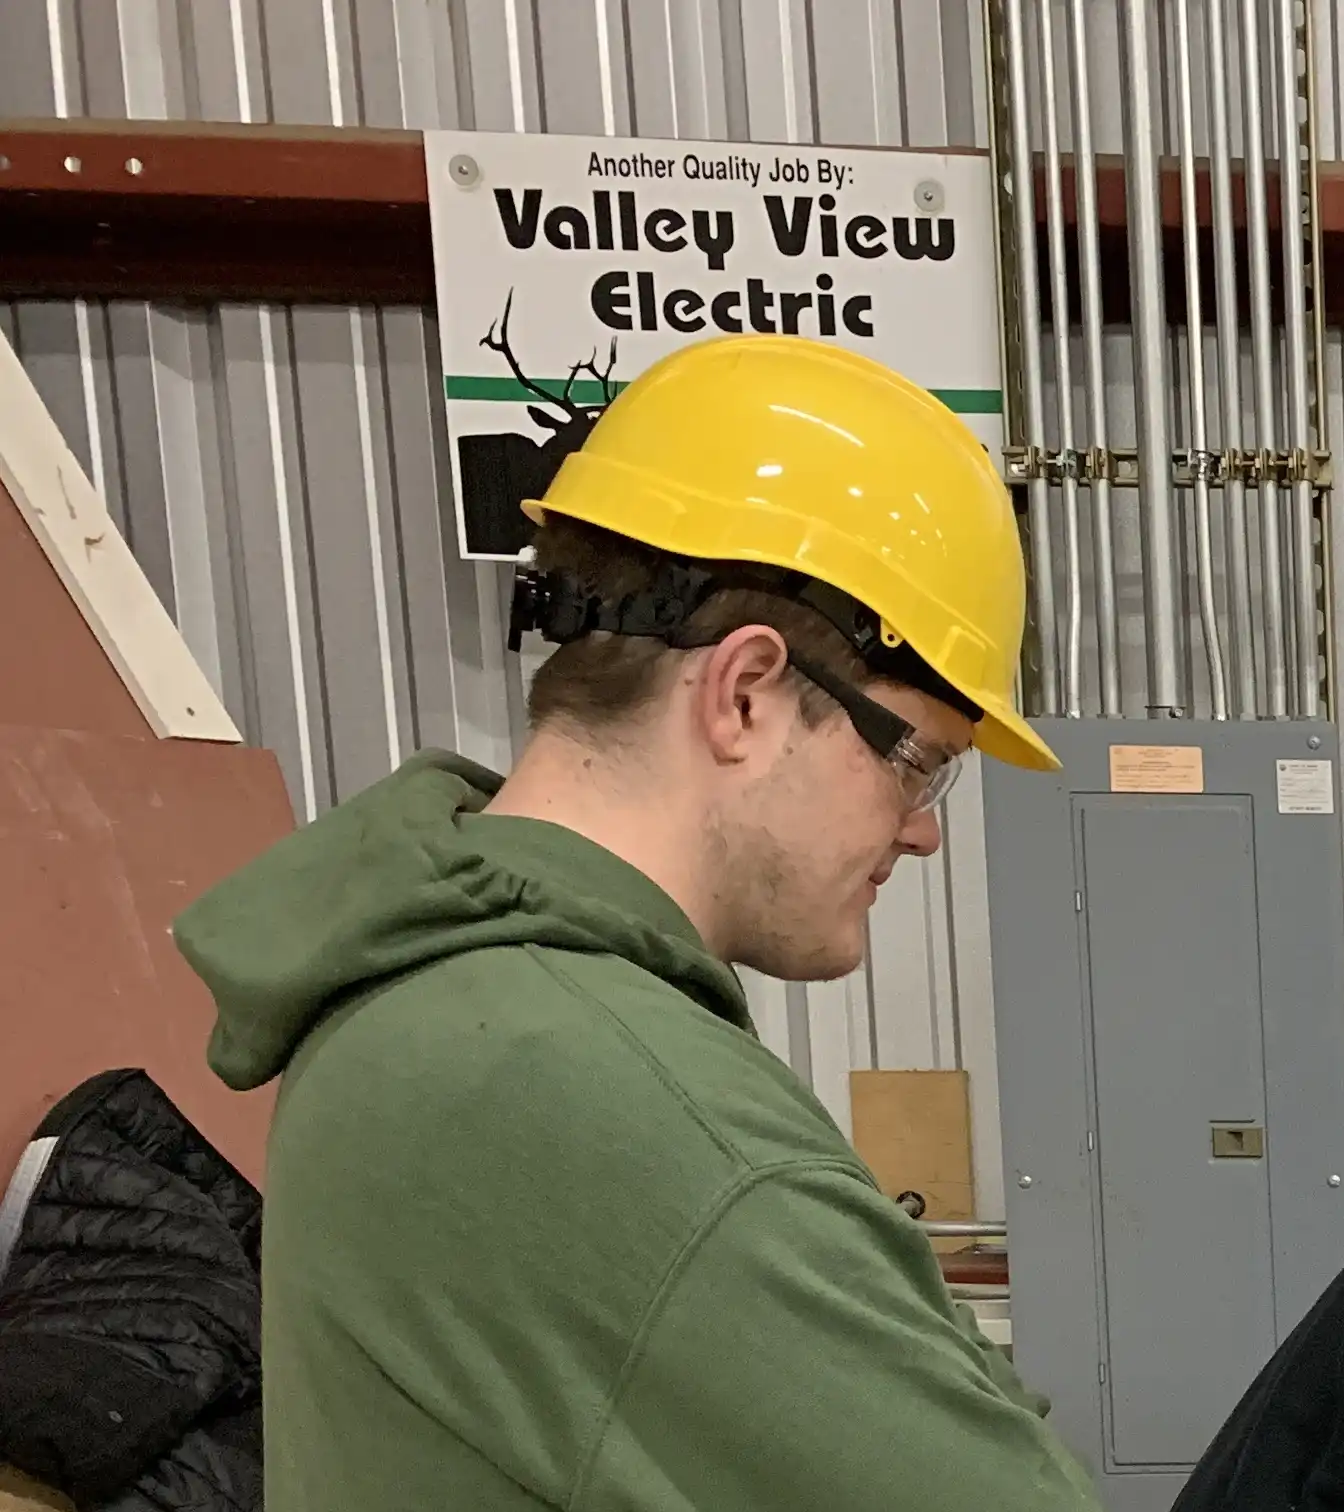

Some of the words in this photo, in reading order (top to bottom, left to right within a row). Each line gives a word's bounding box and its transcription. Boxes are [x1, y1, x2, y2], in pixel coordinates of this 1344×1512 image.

[588, 152, 676, 179] Another
[682, 155, 761, 188] Quality
[769, 159, 809, 183] Job
[817, 161, 854, 189] By:
[494, 188, 735, 270] Valley
[763, 194, 955, 262] View
[591, 271, 874, 337] Electric
